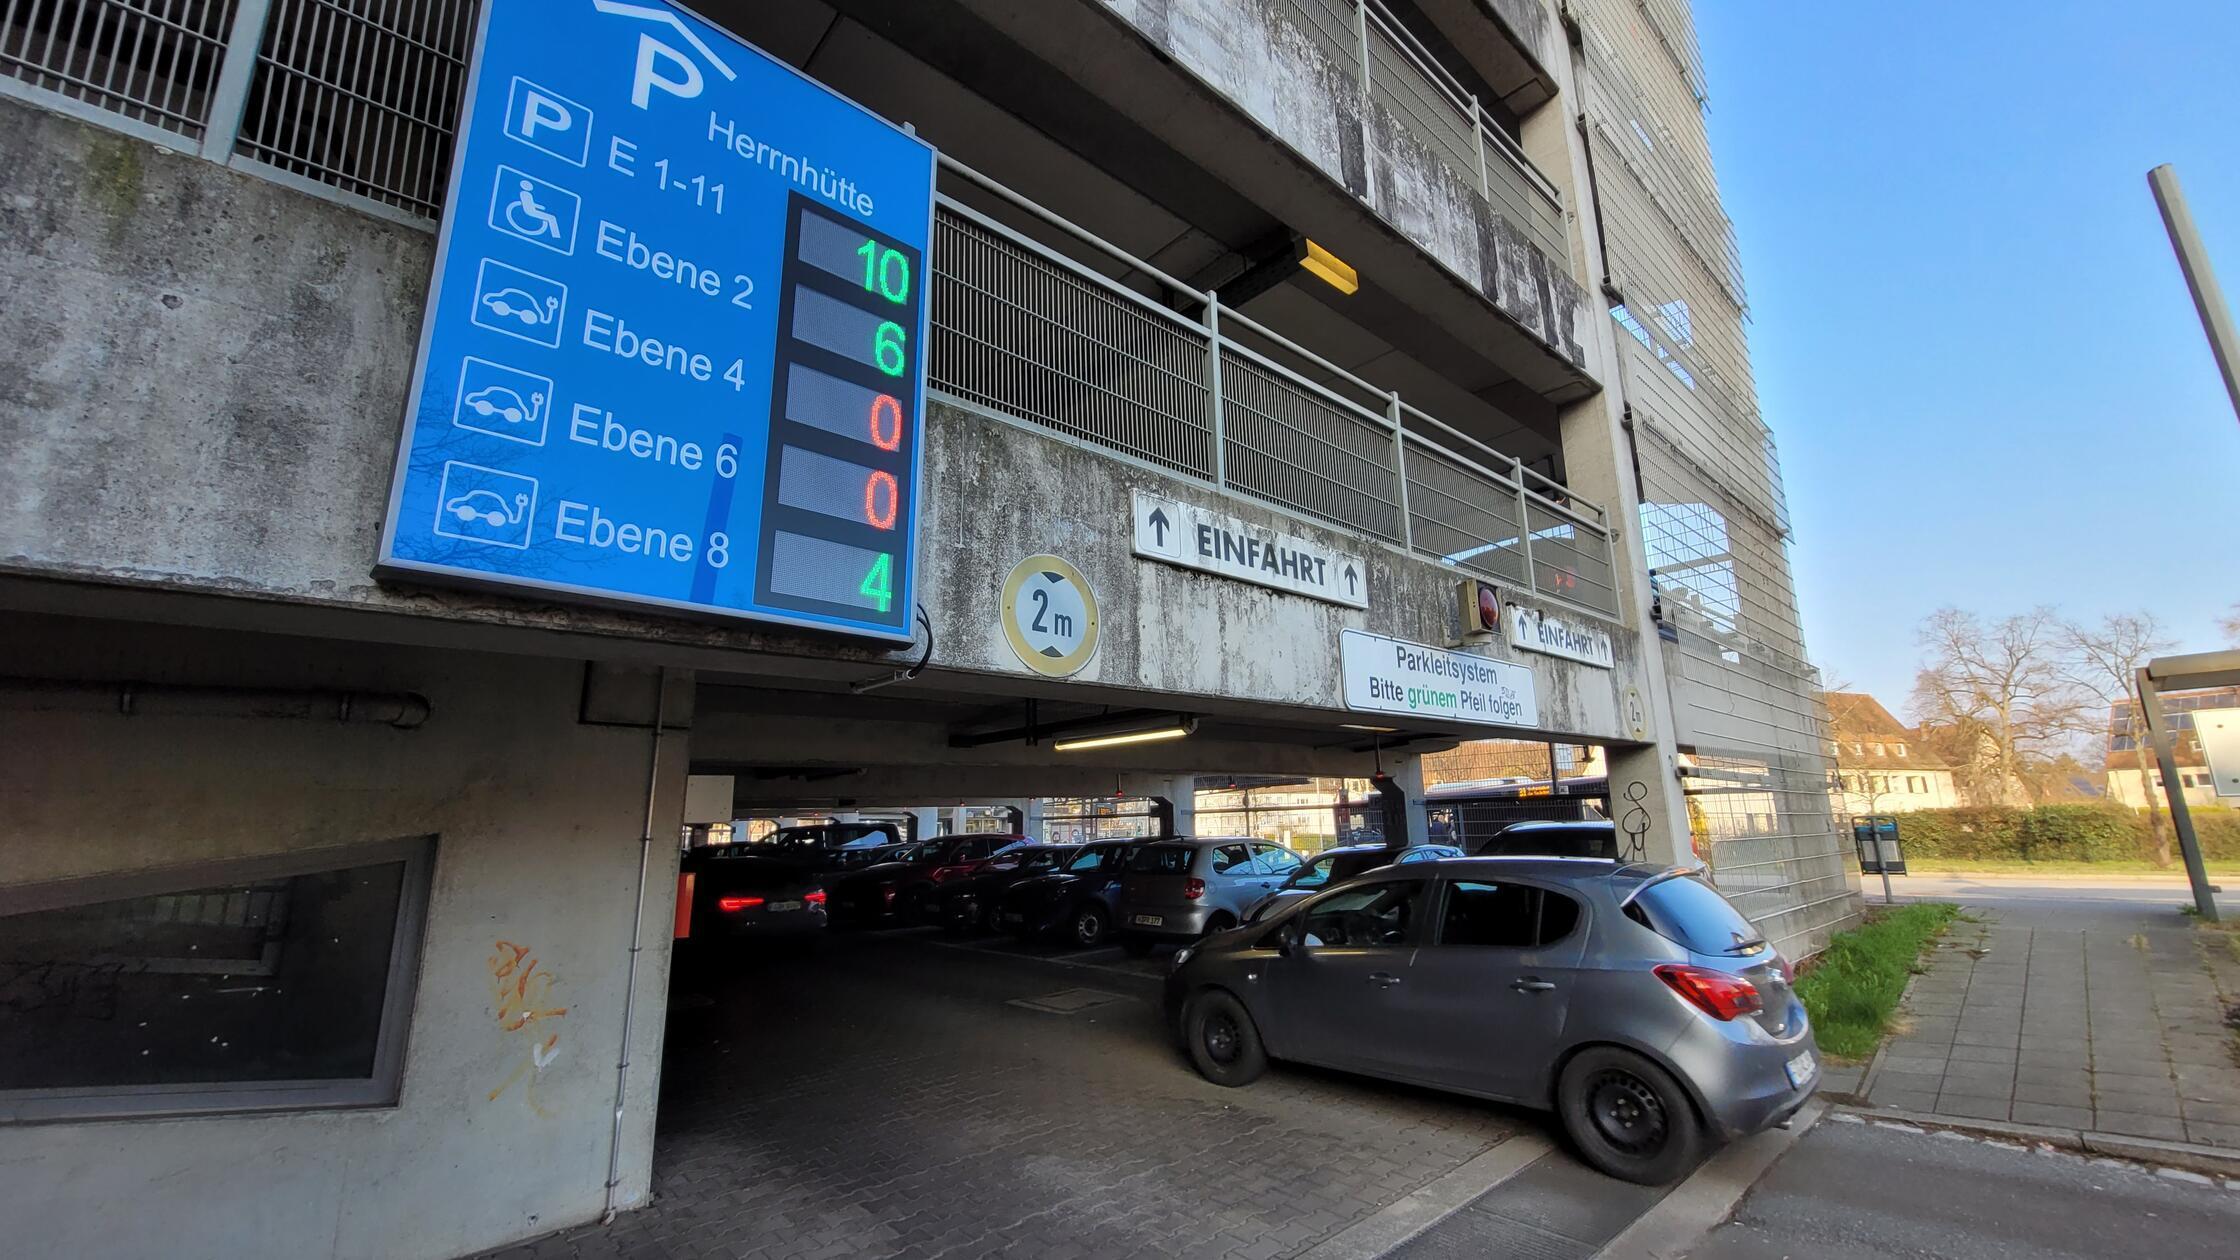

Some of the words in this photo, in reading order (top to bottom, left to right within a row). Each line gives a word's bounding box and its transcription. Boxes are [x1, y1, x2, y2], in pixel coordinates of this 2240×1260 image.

[631, 32, 705, 110] P
[521, 90, 572, 138] P
[608, 135, 638, 178] E
[654, 158, 726, 214] 1-11
[707, 111, 875, 217] Herrnhütte
[596, 220, 722, 296] Ebene
[732, 275, 755, 311] 2
[857, 239, 909, 304] 10
[583, 308, 713, 382] Ebene
[723, 358, 746, 392] 4
[875, 321, 905, 376] 6
[569, 403, 703, 471] Ebene
[715, 443, 739, 479] 6
[870, 394, 902, 450] 0
[865, 471, 897, 530] 0
[554, 500, 694, 563] Ebene
[706, 531, 730, 569] 8
[1199, 522, 1326, 587] EINFAHRT
[860, 552, 892, 613] 4
[1032, 588, 1049, 634] 2
[1054, 612, 1072, 638] m
[1396, 645, 1498, 685] Parkleitsystem
[1537, 622, 1594, 656] EINFAHRT
[1369, 676, 1404, 702] Bitte
[1407, 685, 1457, 709] grünem
[1460, 690, 1487, 713] Pfeil
[1488, 692, 1522, 719] folgen
[1629, 700, 1636, 722] 2
